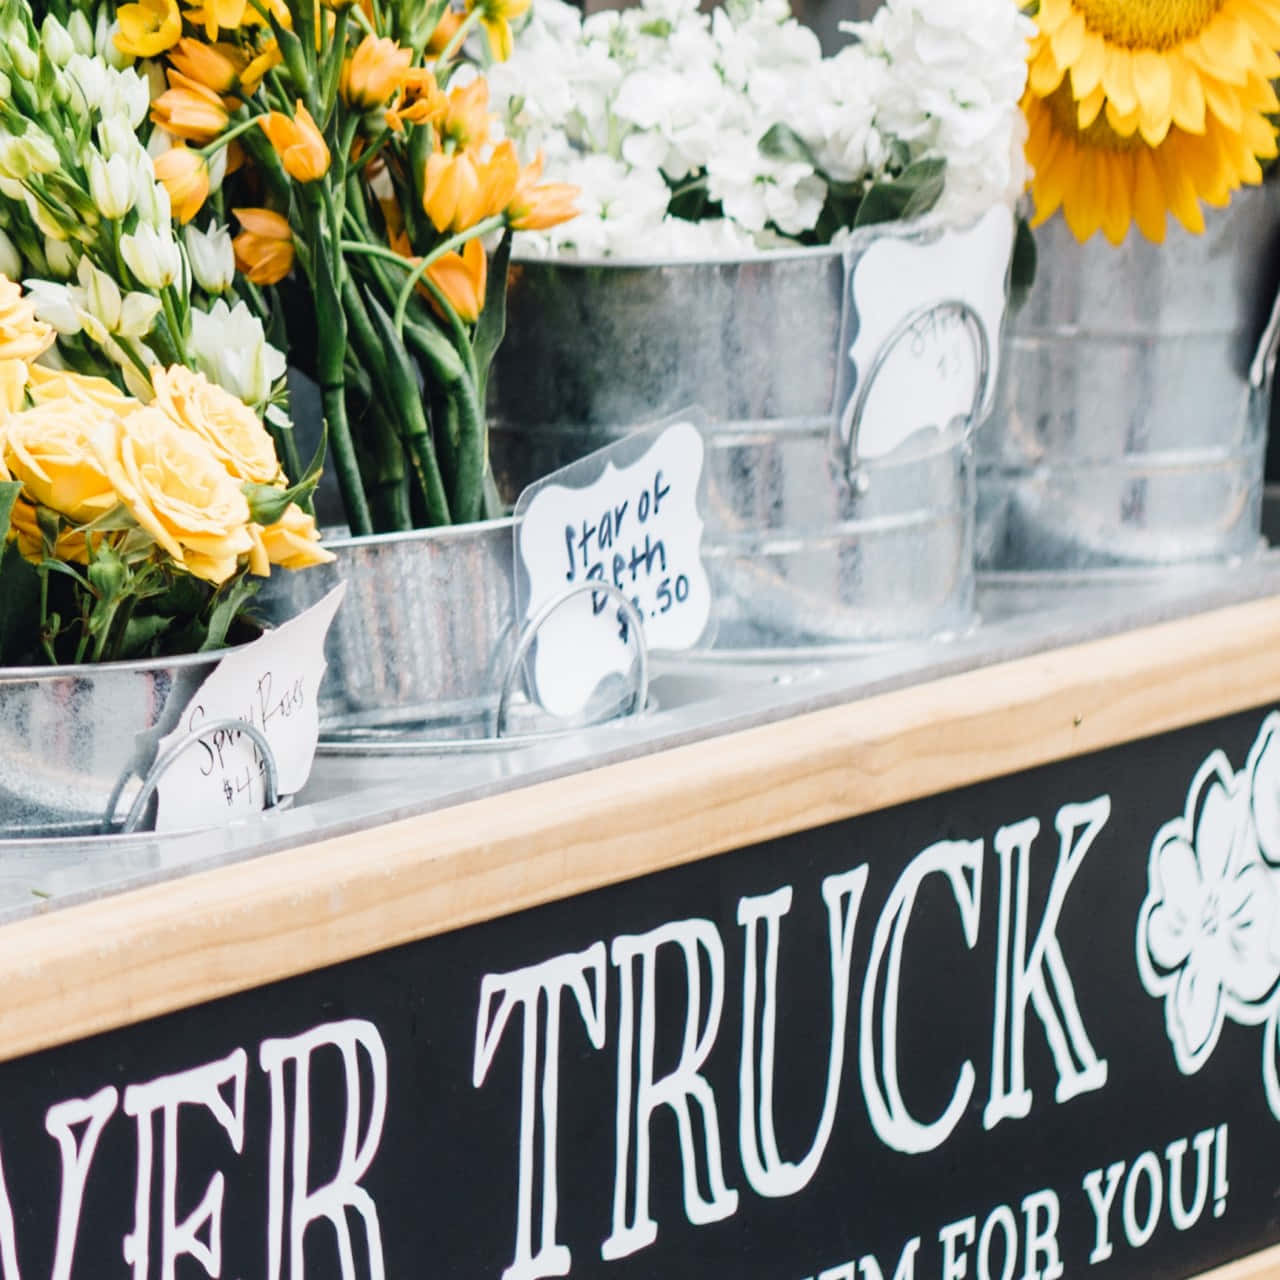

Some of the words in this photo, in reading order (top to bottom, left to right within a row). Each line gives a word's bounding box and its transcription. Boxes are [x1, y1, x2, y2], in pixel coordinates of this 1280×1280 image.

[565, 500, 628, 581] Star
[638, 469, 670, 523] of
[586, 532, 666, 616] Beth
[472, 794, 1112, 1280] TRUCK
[939, 1188, 1064, 1280] FOR
[1082, 1123, 1229, 1266] YOU!
